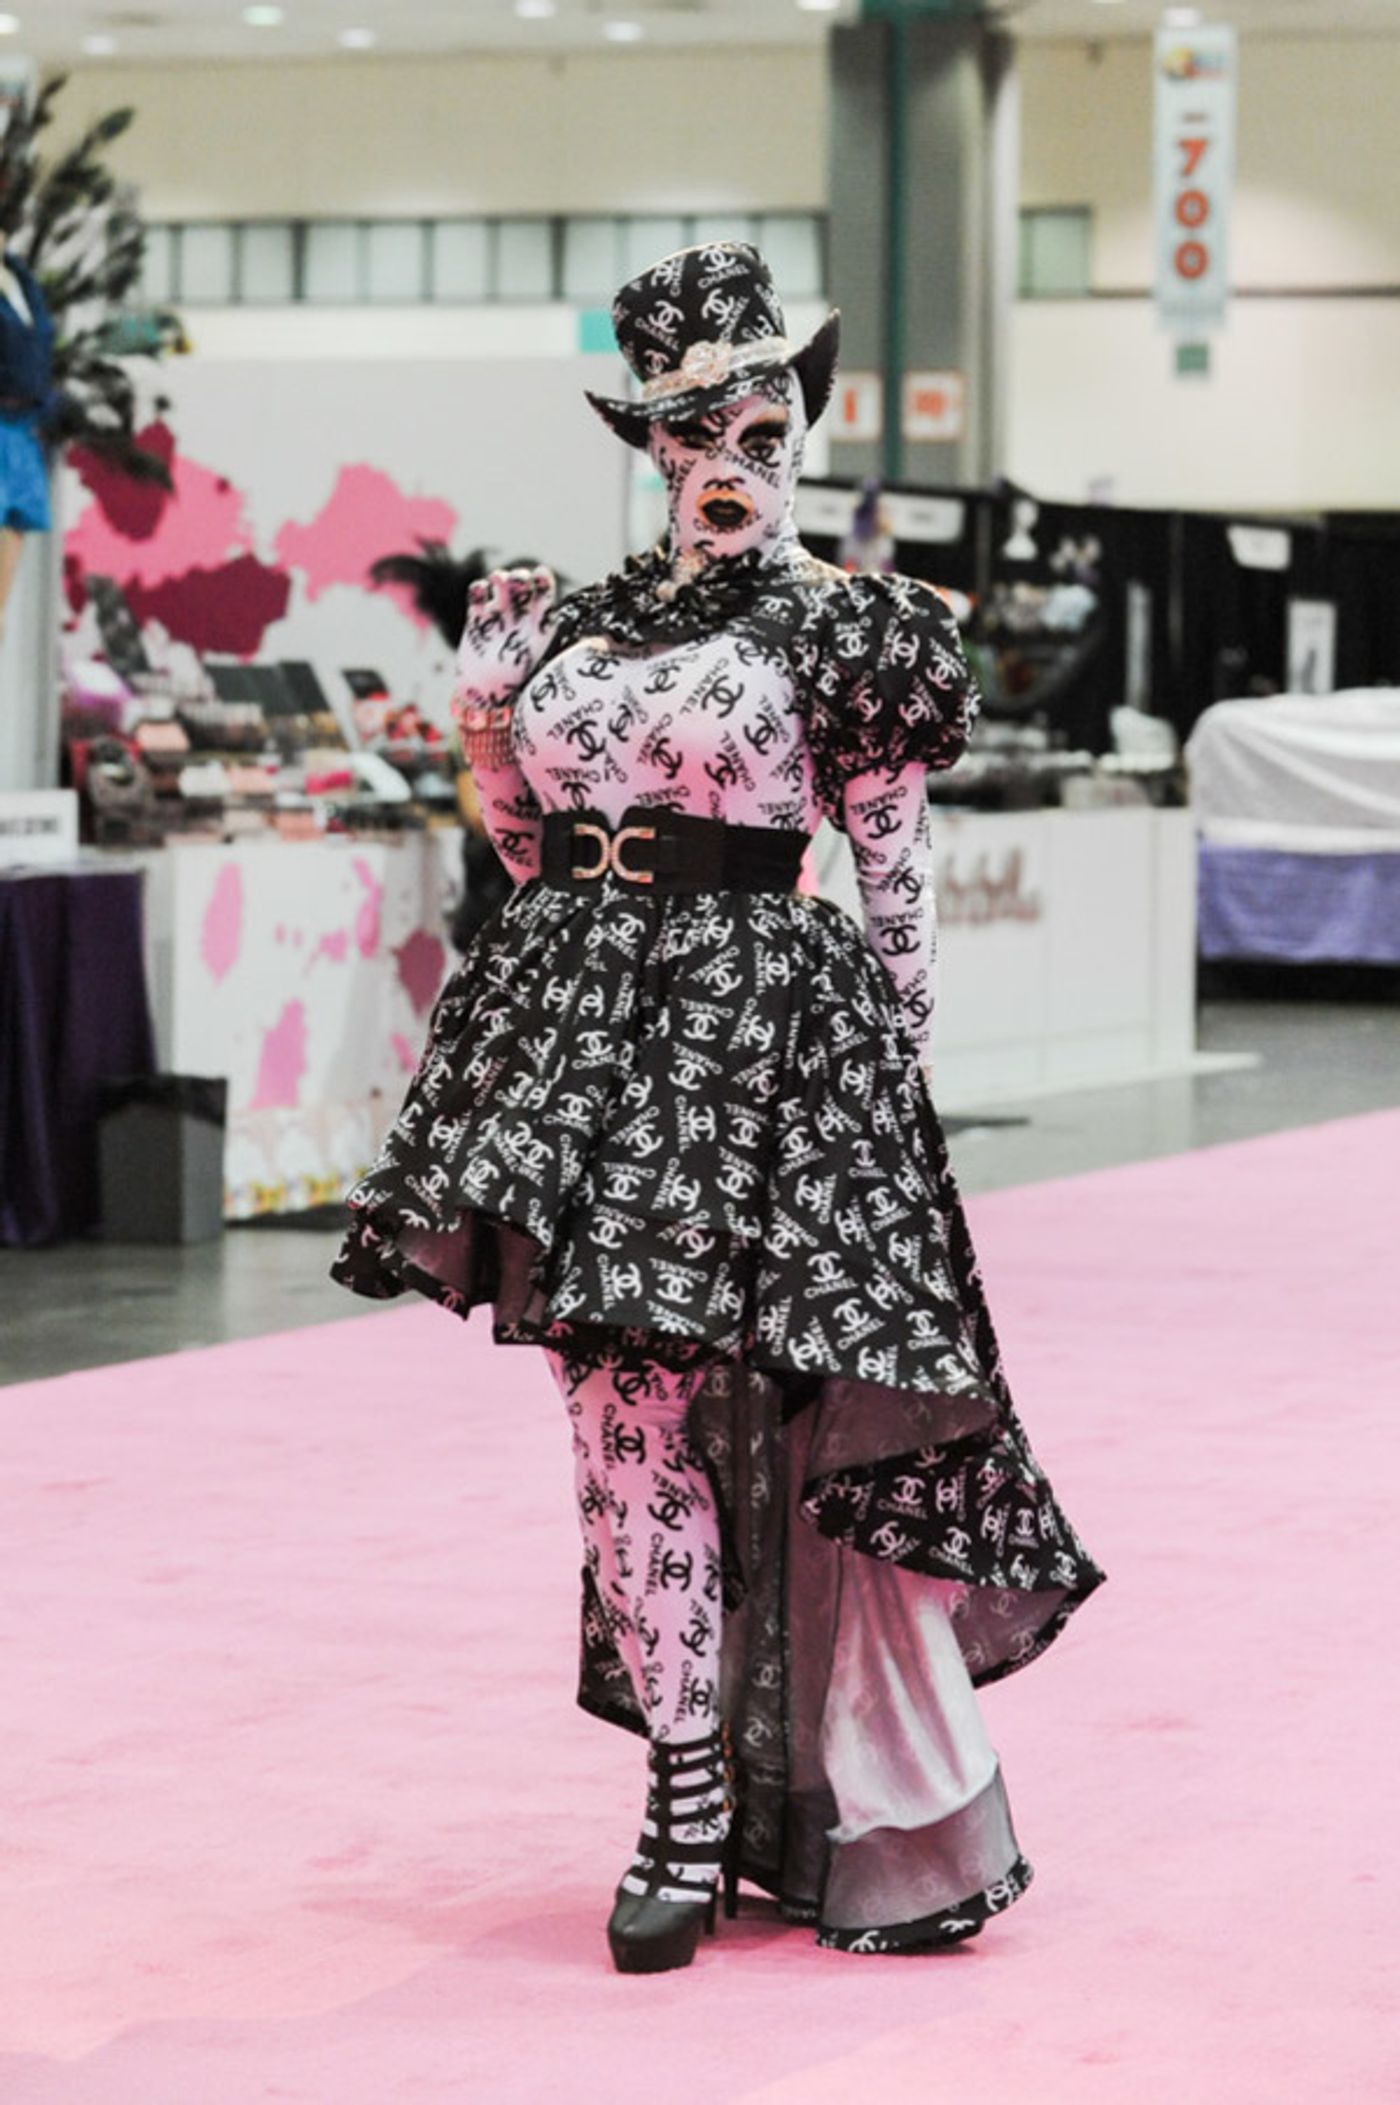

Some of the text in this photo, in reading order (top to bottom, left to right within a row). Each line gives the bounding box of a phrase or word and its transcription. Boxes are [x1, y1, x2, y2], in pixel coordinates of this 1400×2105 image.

[1174, 137, 1209, 280] 700
[698, 264, 749, 291] CHANEL
[679, 657, 729, 715] CHANEL
[547, 700, 604, 739] CHANEL
[758, 694, 790, 743] CHANEL
[637, 713, 672, 766] CHANEL
[545, 767, 601, 783] CHANEL
[604, 749, 628, 783] CHA
[719, 731, 756, 792] CHANEL
[636, 786, 691, 806] CHANEL
[850, 785, 908, 817] CHANEL
[870, 907, 925, 927] CHANEL
[688, 945, 741, 982] CHANEL
[754, 942, 766, 995] CHANEL
[902, 968, 927, 999] CHA
[680, 999, 734, 1018] CHANEL
[727, 998, 757, 1052] CHANEL
[672, 1041, 723, 1075] CHANEL
[731, 1052, 781, 1085] CHANEL
[444, 1109, 471, 1164] CHANEL
[609, 1106, 660, 1144] CHANEL
[675, 1095, 691, 1153] CHANEL
[602, 1162, 657, 1180] CHANEL
[778, 1150, 825, 1176] CHANEL
[404, 1174, 443, 1218] CHANEL
[651, 1157, 680, 1211] CHANEL
[817, 1173, 837, 1225] CHANEL
[592, 1203, 646, 1231] CHANEL
[773, 1206, 819, 1248] CHANEL
[870, 1207, 911, 1232] CHANEL
[597, 1253, 616, 1311] CHANEL
[649, 1257, 709, 1283] CHANEL
[804, 1279, 858, 1299] CHANEL
[705, 1262, 730, 1317] CHANEL
[771, 1296, 793, 1356] CHANEL
[810, 1315, 841, 1373] CHANEL
[837, 1318, 886, 1350] CHANEL
[908, 1334, 951, 1350] CHANEL
[602, 1403, 616, 1469] CHANEL
[877, 1498, 927, 1520] CHANEL
[645, 1533, 663, 1595] CHANEL
[929, 1546, 974, 1575] CHANEL
[674, 1660, 692, 1723] CHANEL
